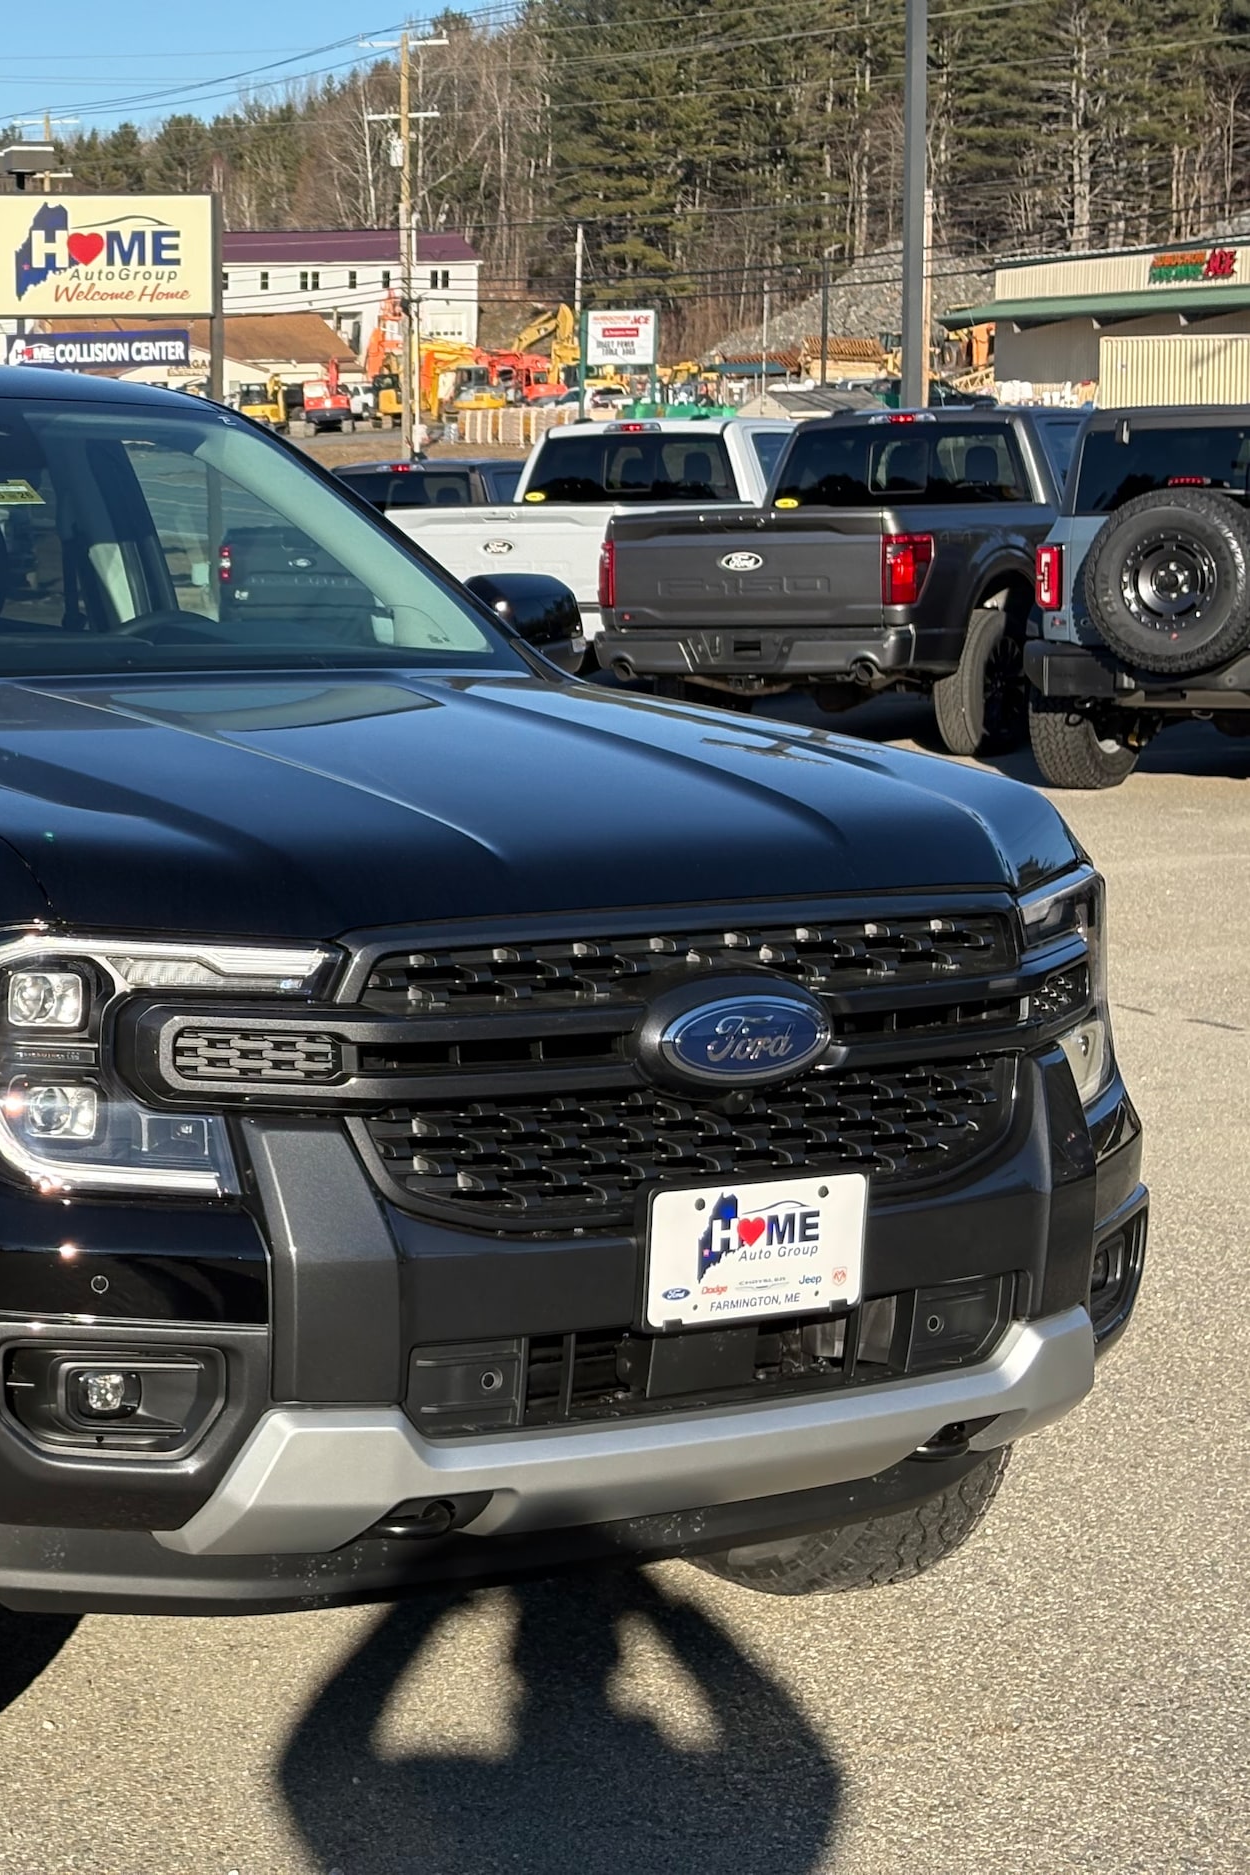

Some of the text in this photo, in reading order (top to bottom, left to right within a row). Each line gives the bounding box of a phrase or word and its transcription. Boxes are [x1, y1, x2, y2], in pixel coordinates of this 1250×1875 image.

[1204, 247, 1237, 278] ACE
[54, 282, 191, 303] Welcome Home
[55, 342, 130, 363] COLLISION
[130, 341, 185, 361] CENTER
[706, 1014, 796, 1062] Ford
[738, 1245, 819, 1262] Auto Group
[701, 1284, 728, 1296] Dodge
[798, 1274, 822, 1286] Jeep
[666, 1290, 686, 1300] Ford
[709, 1292, 801, 1312] FARMINGTON, ME
